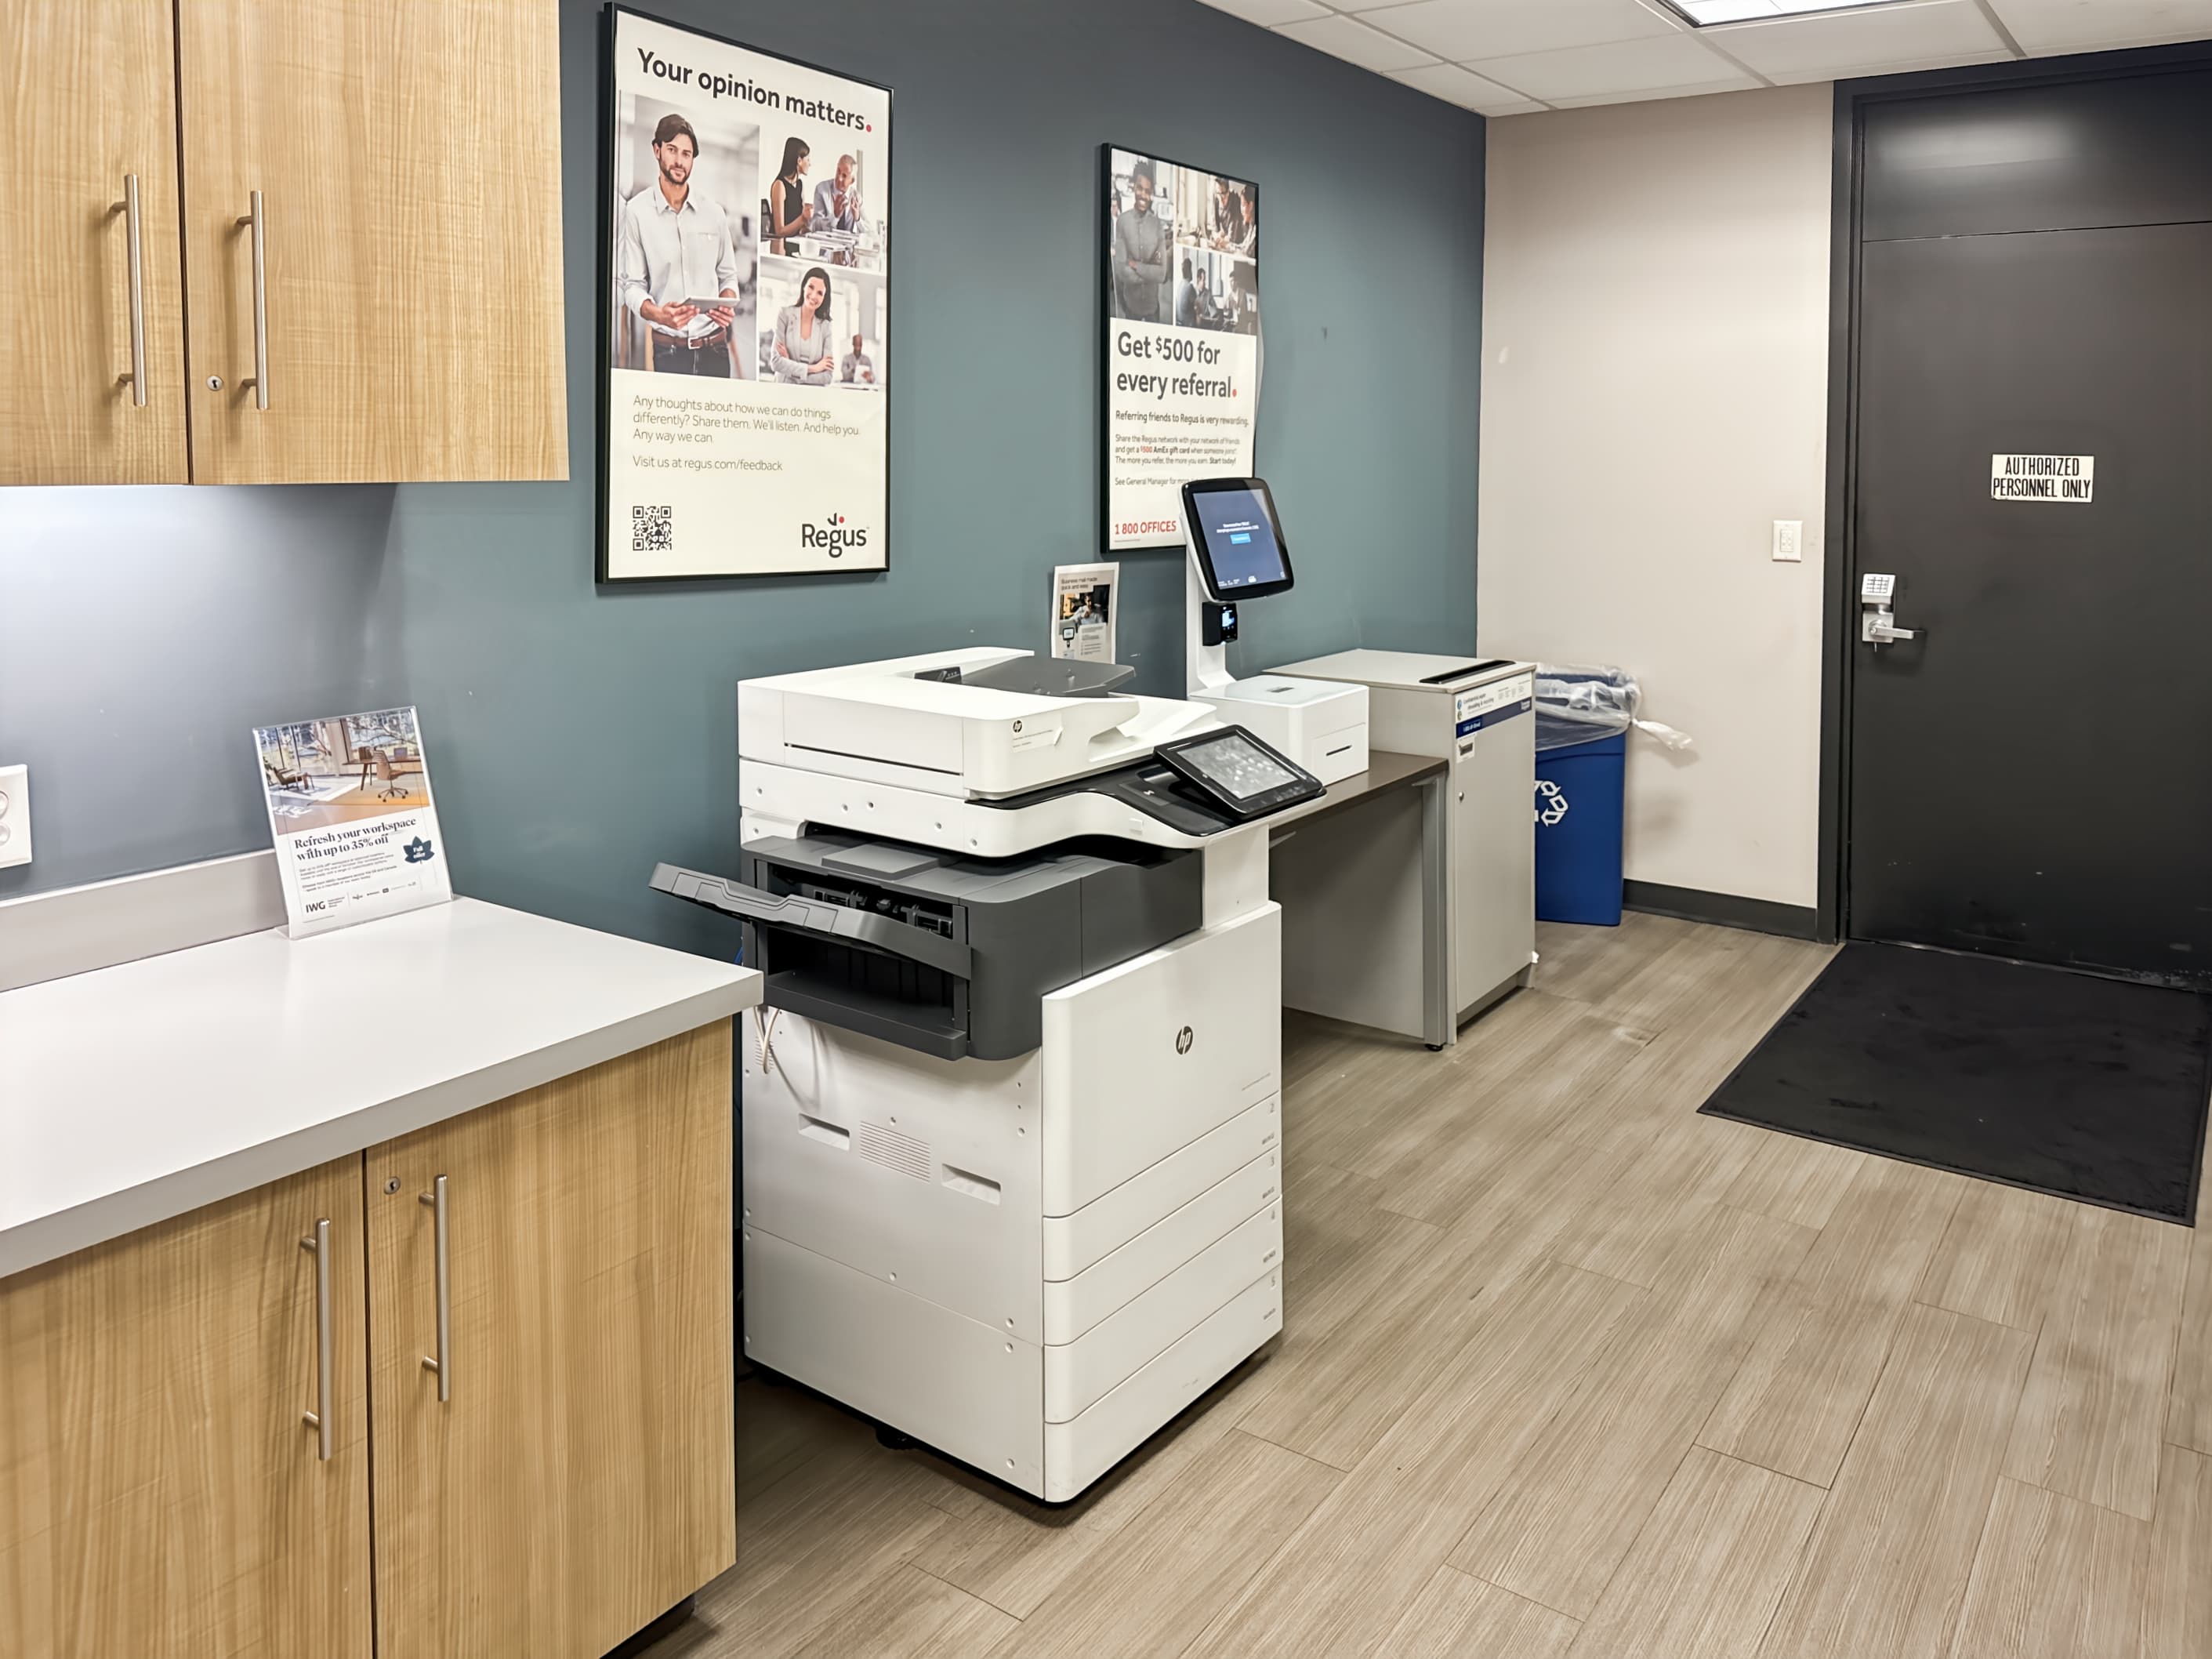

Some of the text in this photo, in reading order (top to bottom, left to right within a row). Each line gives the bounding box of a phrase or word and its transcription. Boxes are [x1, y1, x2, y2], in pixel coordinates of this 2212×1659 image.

[637, 47, 872, 133] Your opinion matters.
[1118, 331, 1220, 365] Get $500 for
[1117, 372, 1237, 400] every referral.
[633, 395, 832, 421] Any thoughts about how we can do things
[1115, 410, 1148, 424] Referring
[1148, 412, 1171, 423] friends
[1172, 413, 1180, 423] to
[1180, 414, 1199, 426] Regus
[1200, 414, 1205, 423] is
[1206, 416, 1219, 427] very
[633, 412, 691, 427] differently?
[692, 415, 721, 428] Share
[723, 417, 751, 429] them.
[753, 419, 774, 430] We'll
[803, 423, 821, 433] And
[822, 423, 841, 436] help
[633, 428, 653, 442] Any
[655, 431, 676, 444] way
[678, 432, 692, 442] we
[633, 456, 655, 468] Visit
[657, 458, 669, 468] us
[672, 457, 683, 468] at
[1169, 445, 1179, 456] gift
[2005, 456, 2080, 477] AUTHORIZED
[1993, 477, 2091, 499] PERSONNEL ONLY
[1115, 521, 1177, 535] 1 800 OFFICES
[802, 523, 868, 558] Regus
[294, 818, 417, 849] Refresh your workspace
[296, 833, 390, 862] with up to 35% off
[306, 901, 326, 913] IWG
[1176, 1026, 1193, 1055] hp
